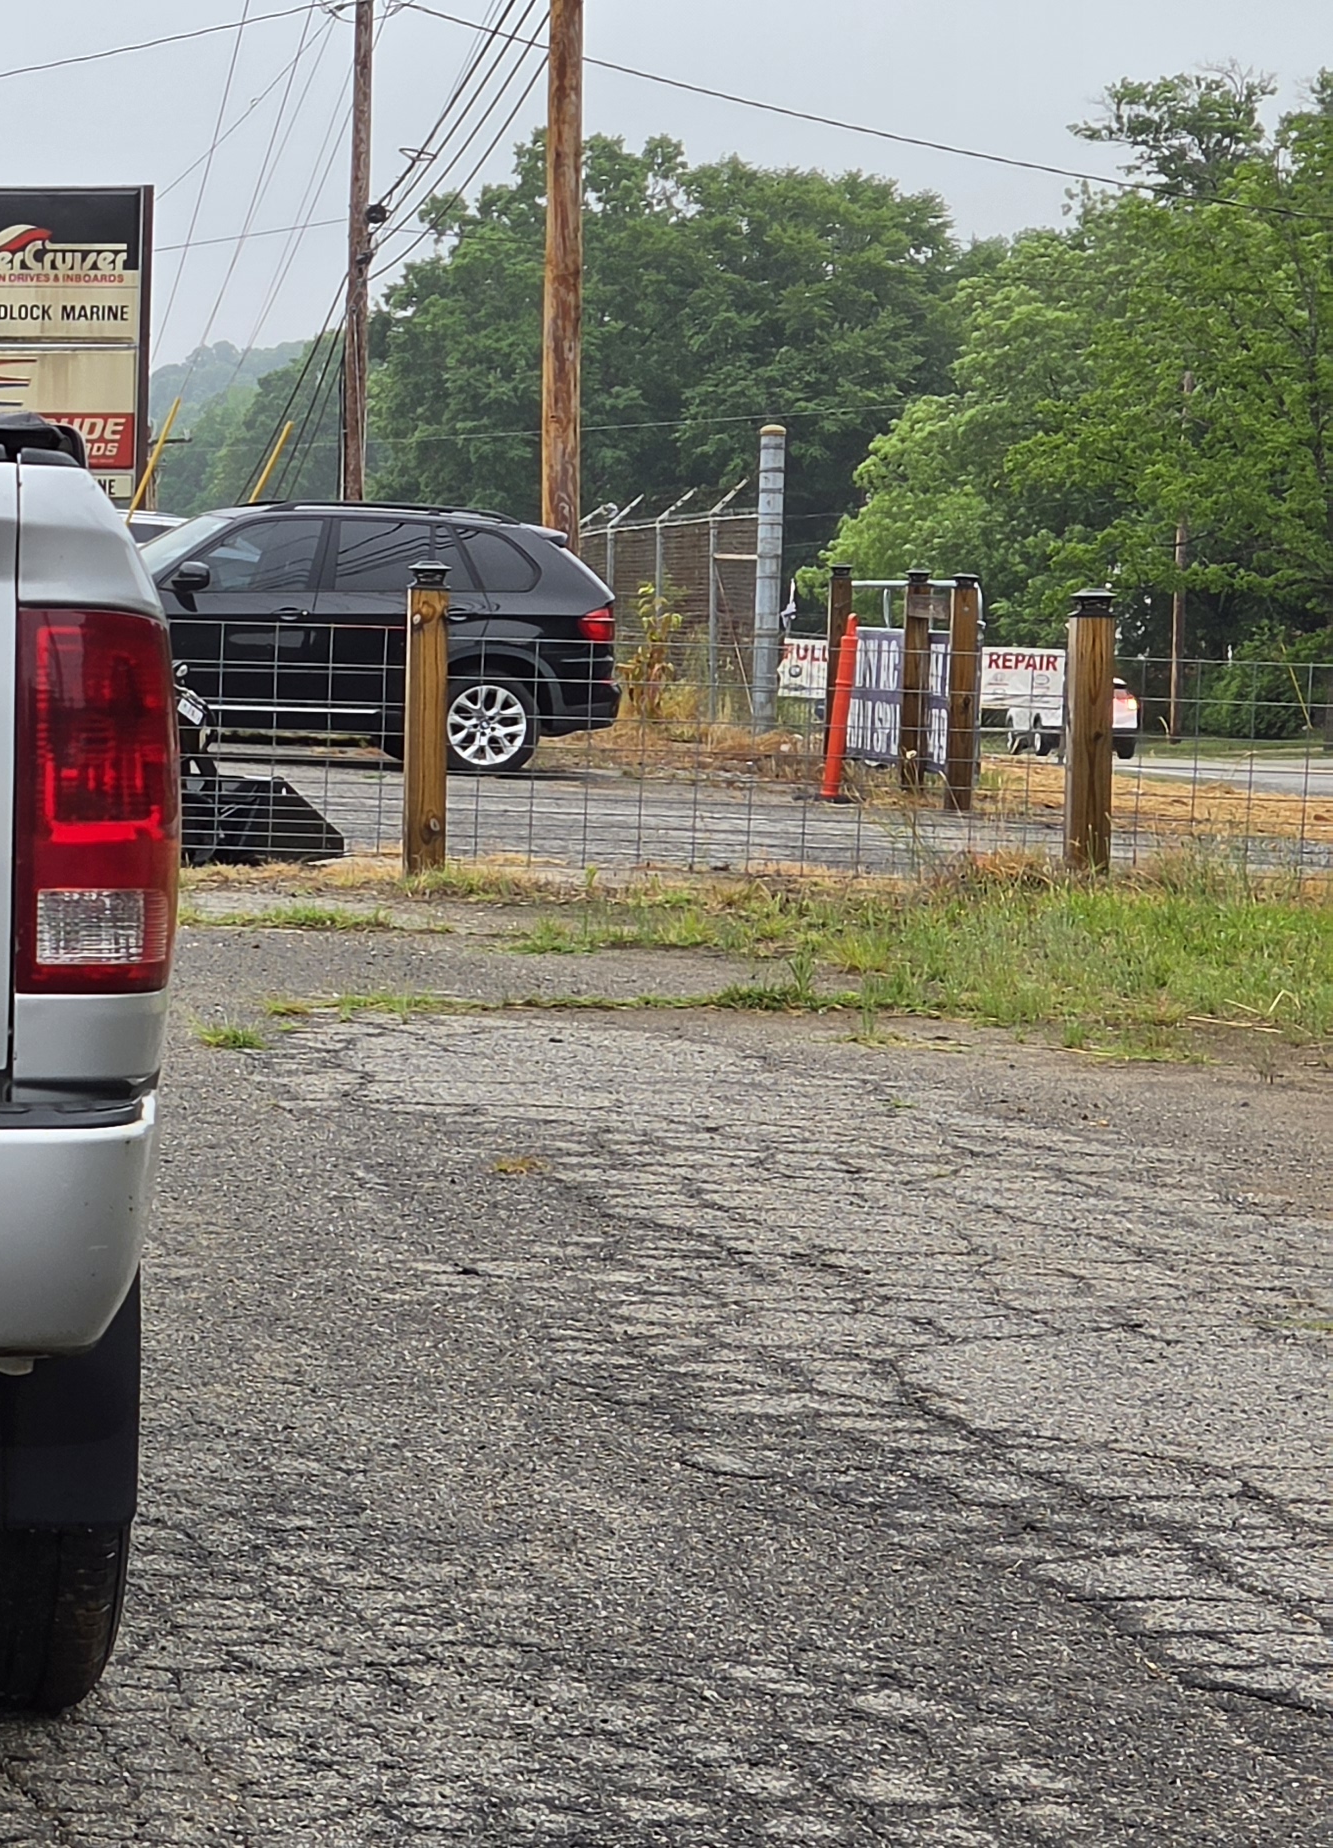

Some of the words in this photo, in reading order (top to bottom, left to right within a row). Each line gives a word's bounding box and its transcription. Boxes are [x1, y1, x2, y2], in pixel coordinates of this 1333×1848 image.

[8, 273, 51, 283] DRIVES
[53, 273, 60, 283] &
[62, 273, 125, 283] INBOARDS
[61, 304, 130, 321] MARINE
[987, 651, 1059, 672] REPAIR
